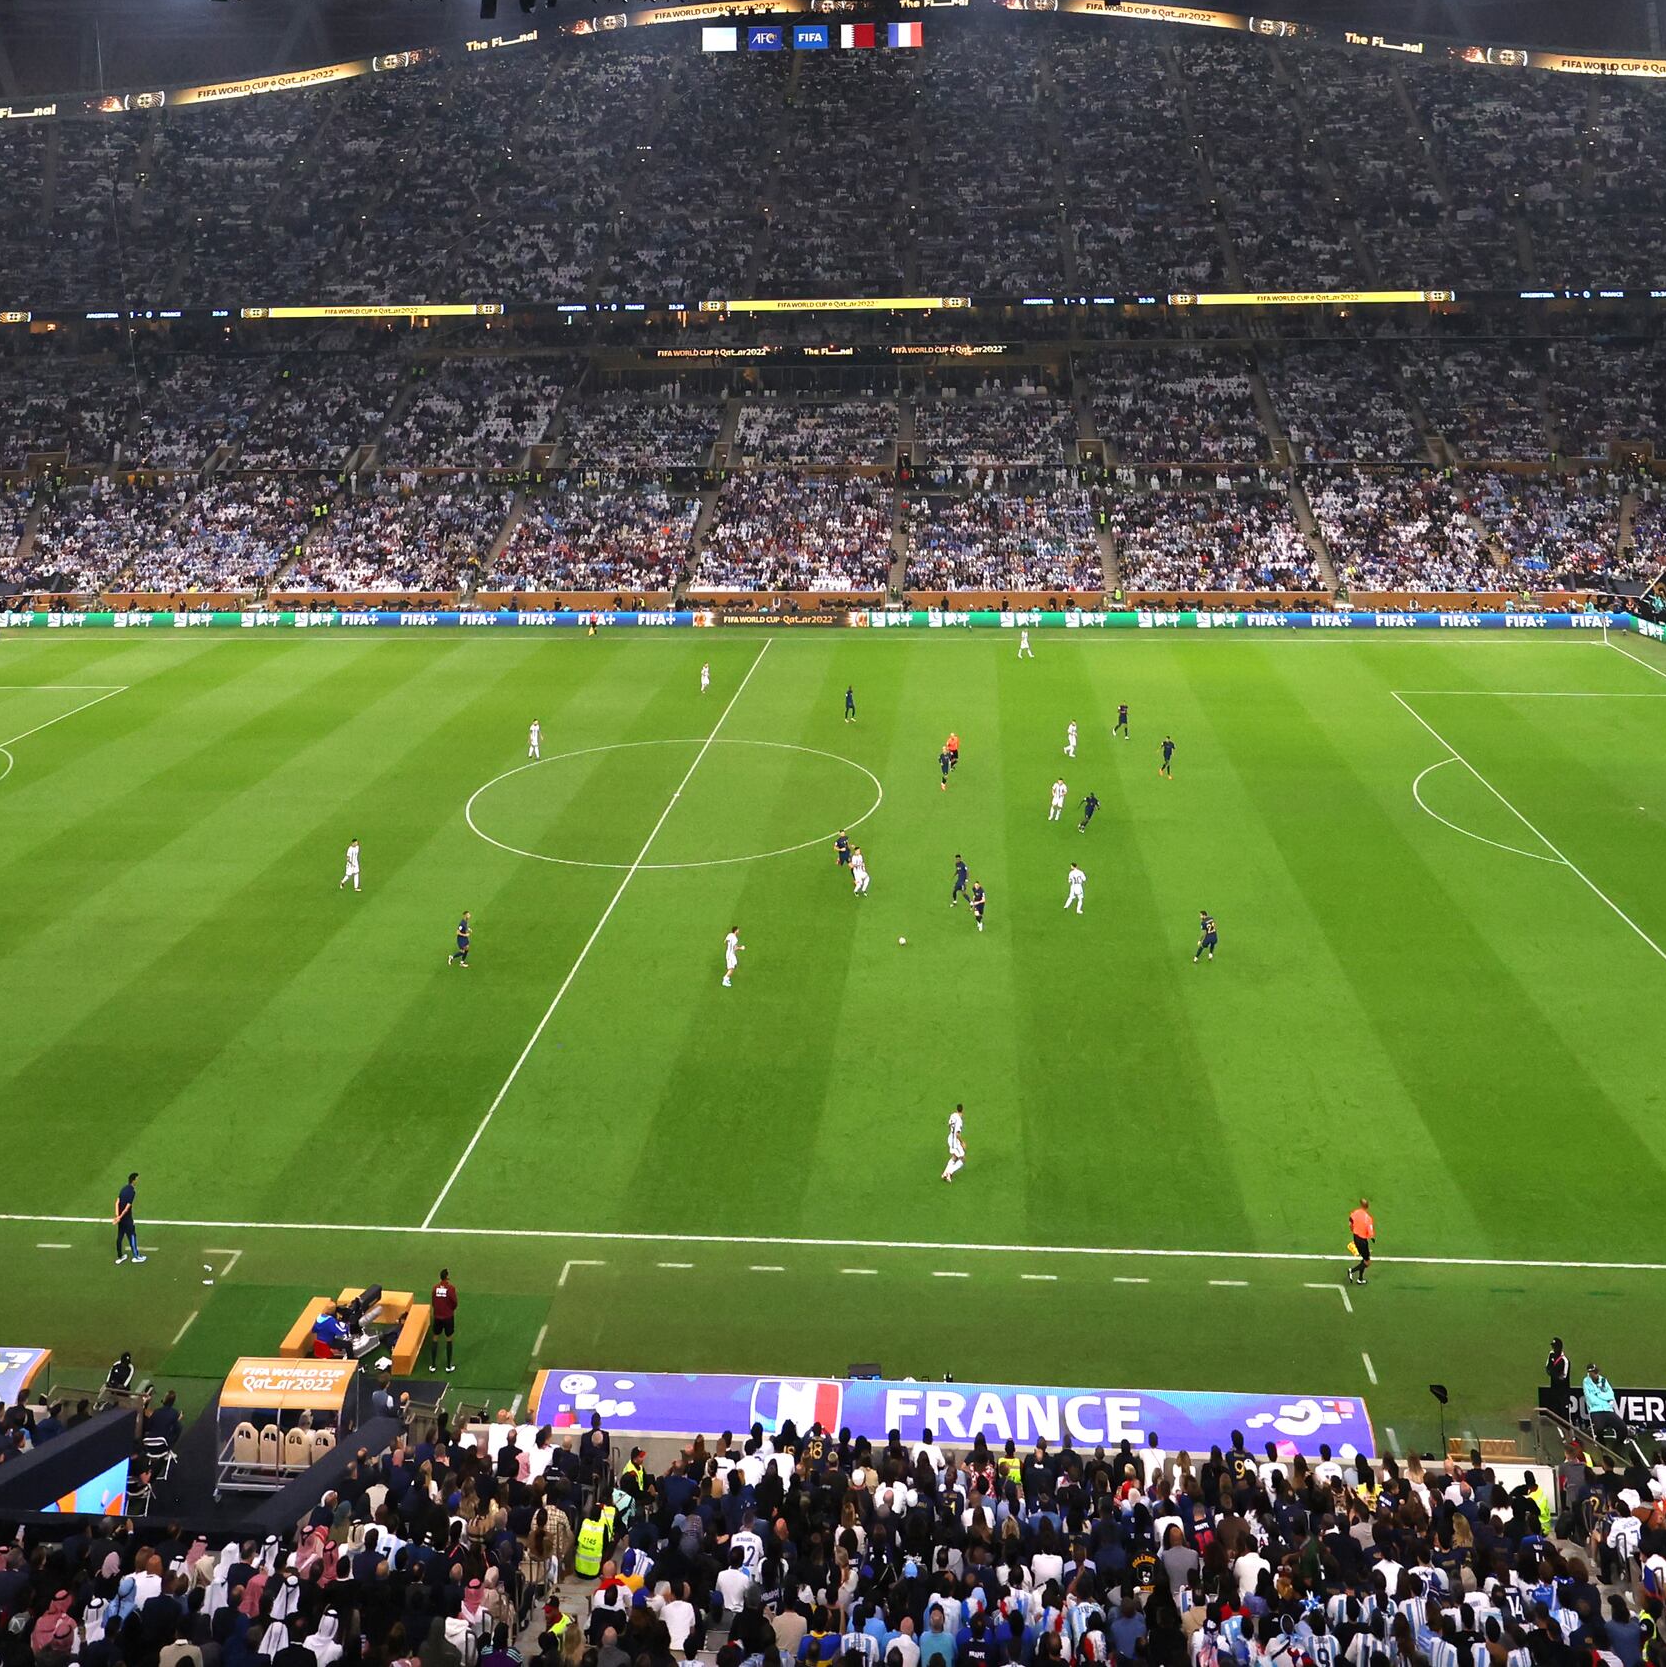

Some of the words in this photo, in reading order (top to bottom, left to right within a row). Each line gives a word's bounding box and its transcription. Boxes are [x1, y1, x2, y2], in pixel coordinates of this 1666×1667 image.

[900, 0, 921, 8] The
[1086, 3, 1104, 12] FIFA
[1106, 4, 1133, 14] WORLD
[1135, 6, 1150, 15] CUP
[751, 33, 774, 45] AFC
[799, 33, 823, 43] FIFA
[1345, 33, 1369, 45] The
[466, 41, 489, 52] The
[1562, 60, 1582, 69] FIFA
[1584, 61, 1619, 71] WORLD
[1621, 64, 1640, 72] CUP
[198, 90, 217, 99] FIFA
[218, 85, 250, 97] WORLD
[250, 81, 269, 92] CUP
[673, 349, 698, 357] WORLD
[699, 349, 713, 357] CUP
[804, 348, 818, 356] The
[724, 615, 739, 623] FIFA
[739, 615, 765, 623] WORLD
[766, 615, 780, 623] CUP
[243, 1367, 270, 1376] FIFA
[273, 1368, 318, 1378] WORLD
[319, 1369, 345, 1378] CUP
[885, 1389, 1145, 1444] FRANCE
[808, 1440, 823, 1460] 18
